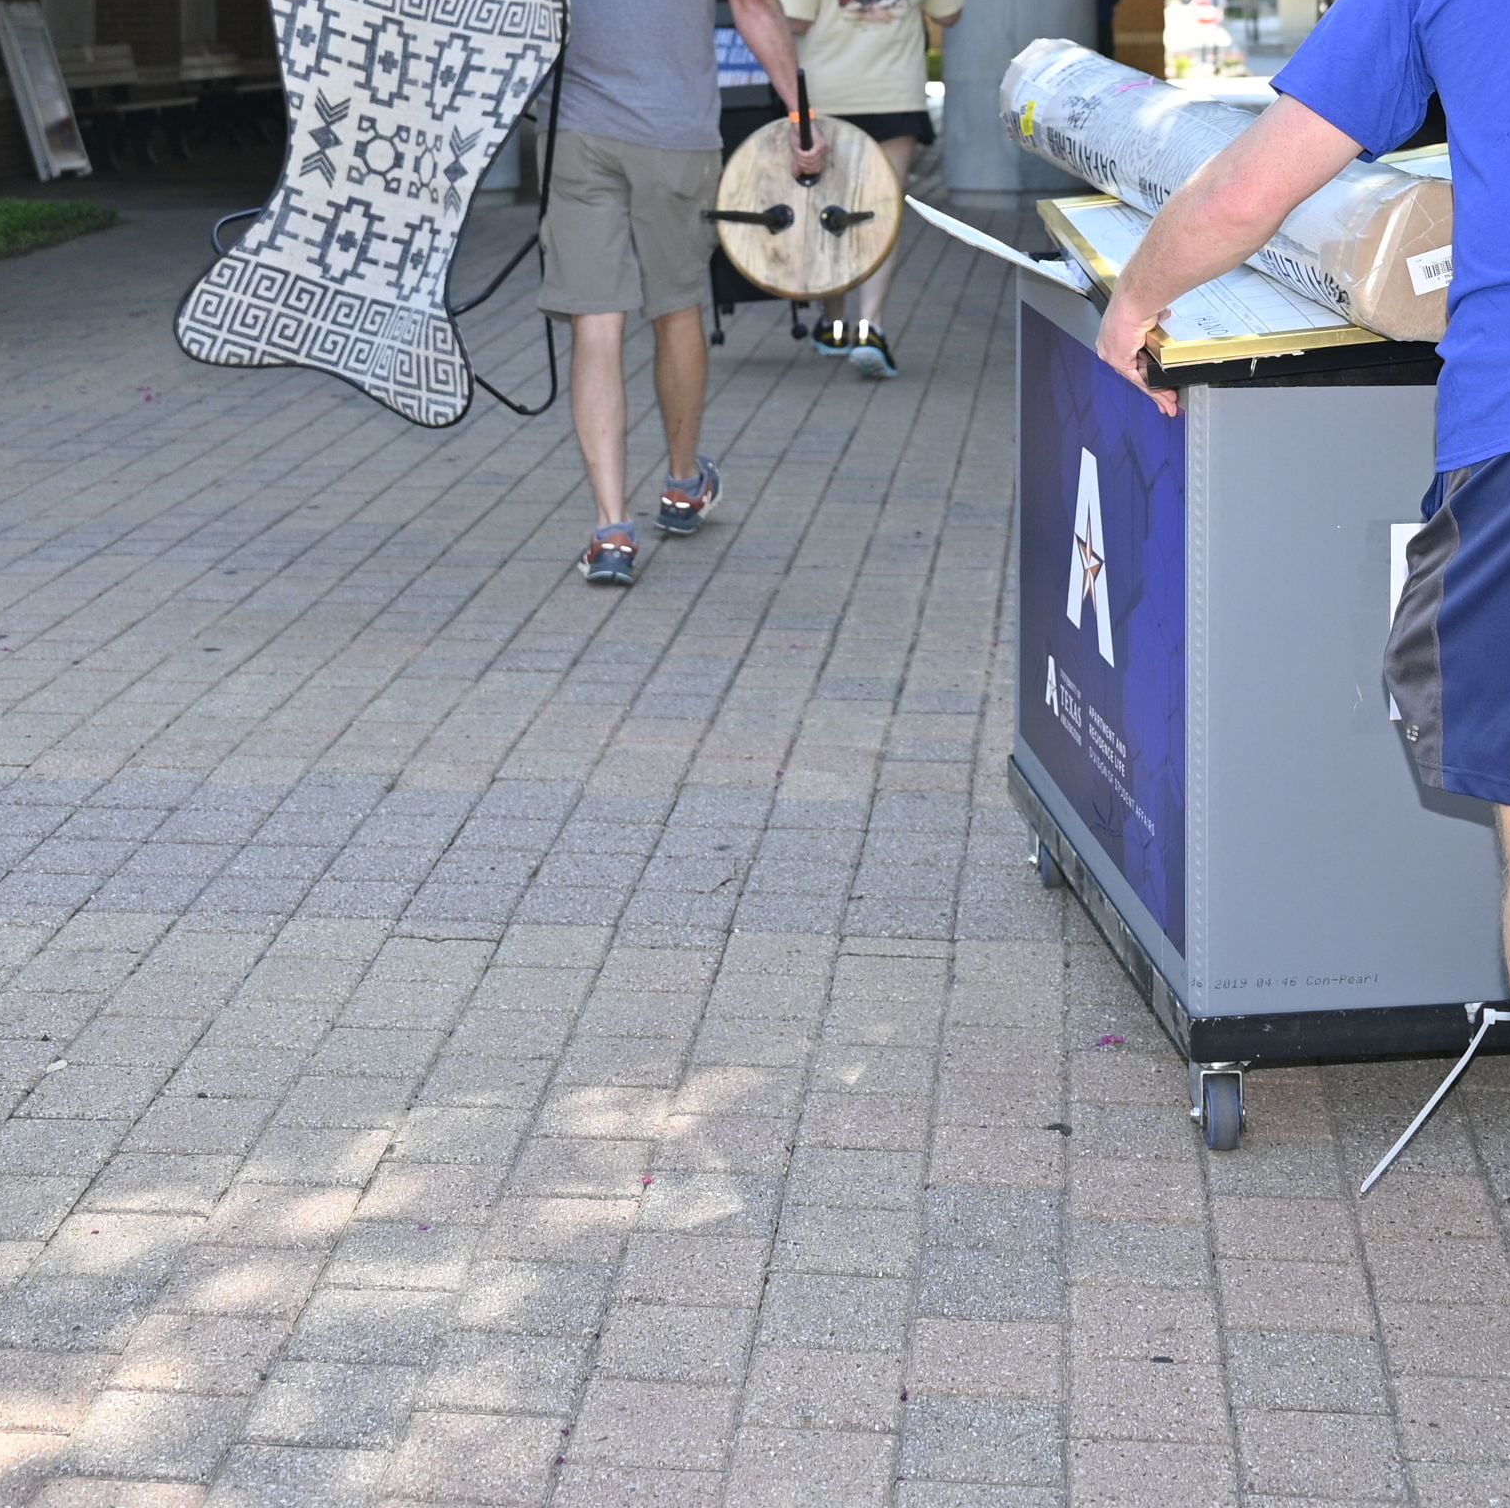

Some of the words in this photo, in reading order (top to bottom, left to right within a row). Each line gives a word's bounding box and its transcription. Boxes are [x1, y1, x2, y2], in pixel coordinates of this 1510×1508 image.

[1059, 683, 1082, 728] TEXAS
[1089, 704, 1115, 745] APARTMENT
[1115, 737, 1126, 759] AND
[1089, 723, 1114, 764] RESIDENCE
[1114, 754, 1125, 778] LIFE
[1089, 745, 1108, 778] DIVISION
[1107, 770, 1114, 784] OF
[1114, 777, 1135, 811] STUDENT
[1136, 804, 1155, 836] AFFAIRS
[1214, 978, 1248, 990] 2019
[1306, 973, 1379, 987] Con-Pearl
